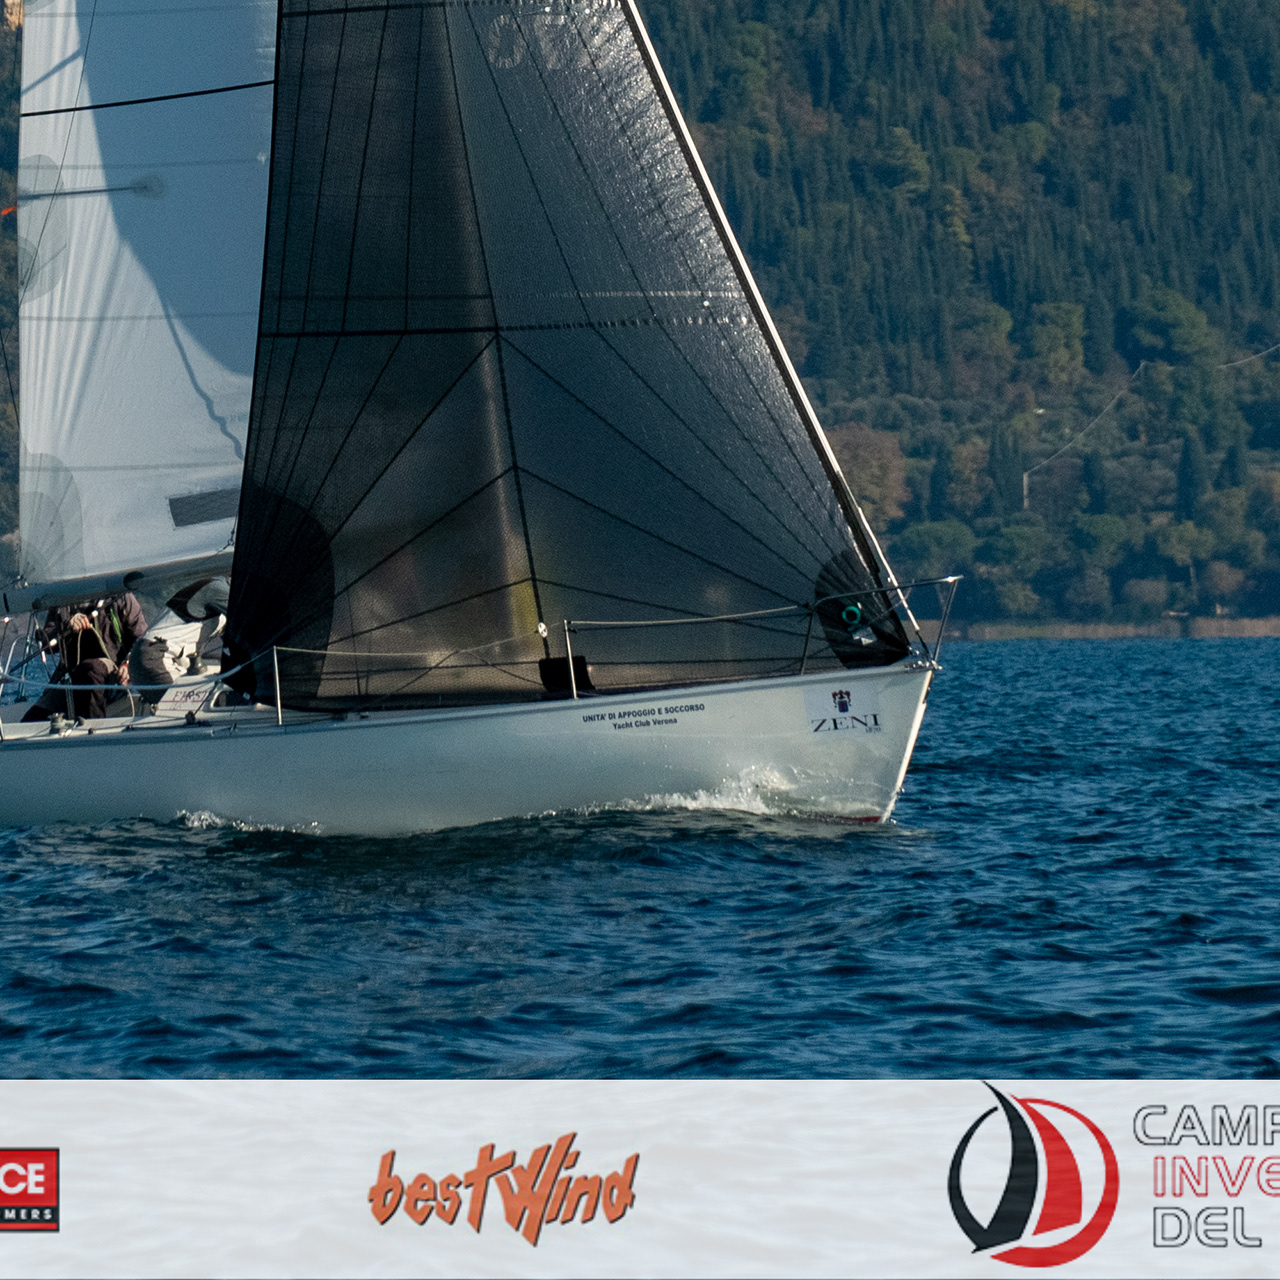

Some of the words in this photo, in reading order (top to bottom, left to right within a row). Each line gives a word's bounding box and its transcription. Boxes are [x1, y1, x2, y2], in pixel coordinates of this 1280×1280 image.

[618, 709, 655, 719] APPOGGIO
[665, 704, 705, 714] SOCCORSO
[811, 714, 880, 732] ZENI
